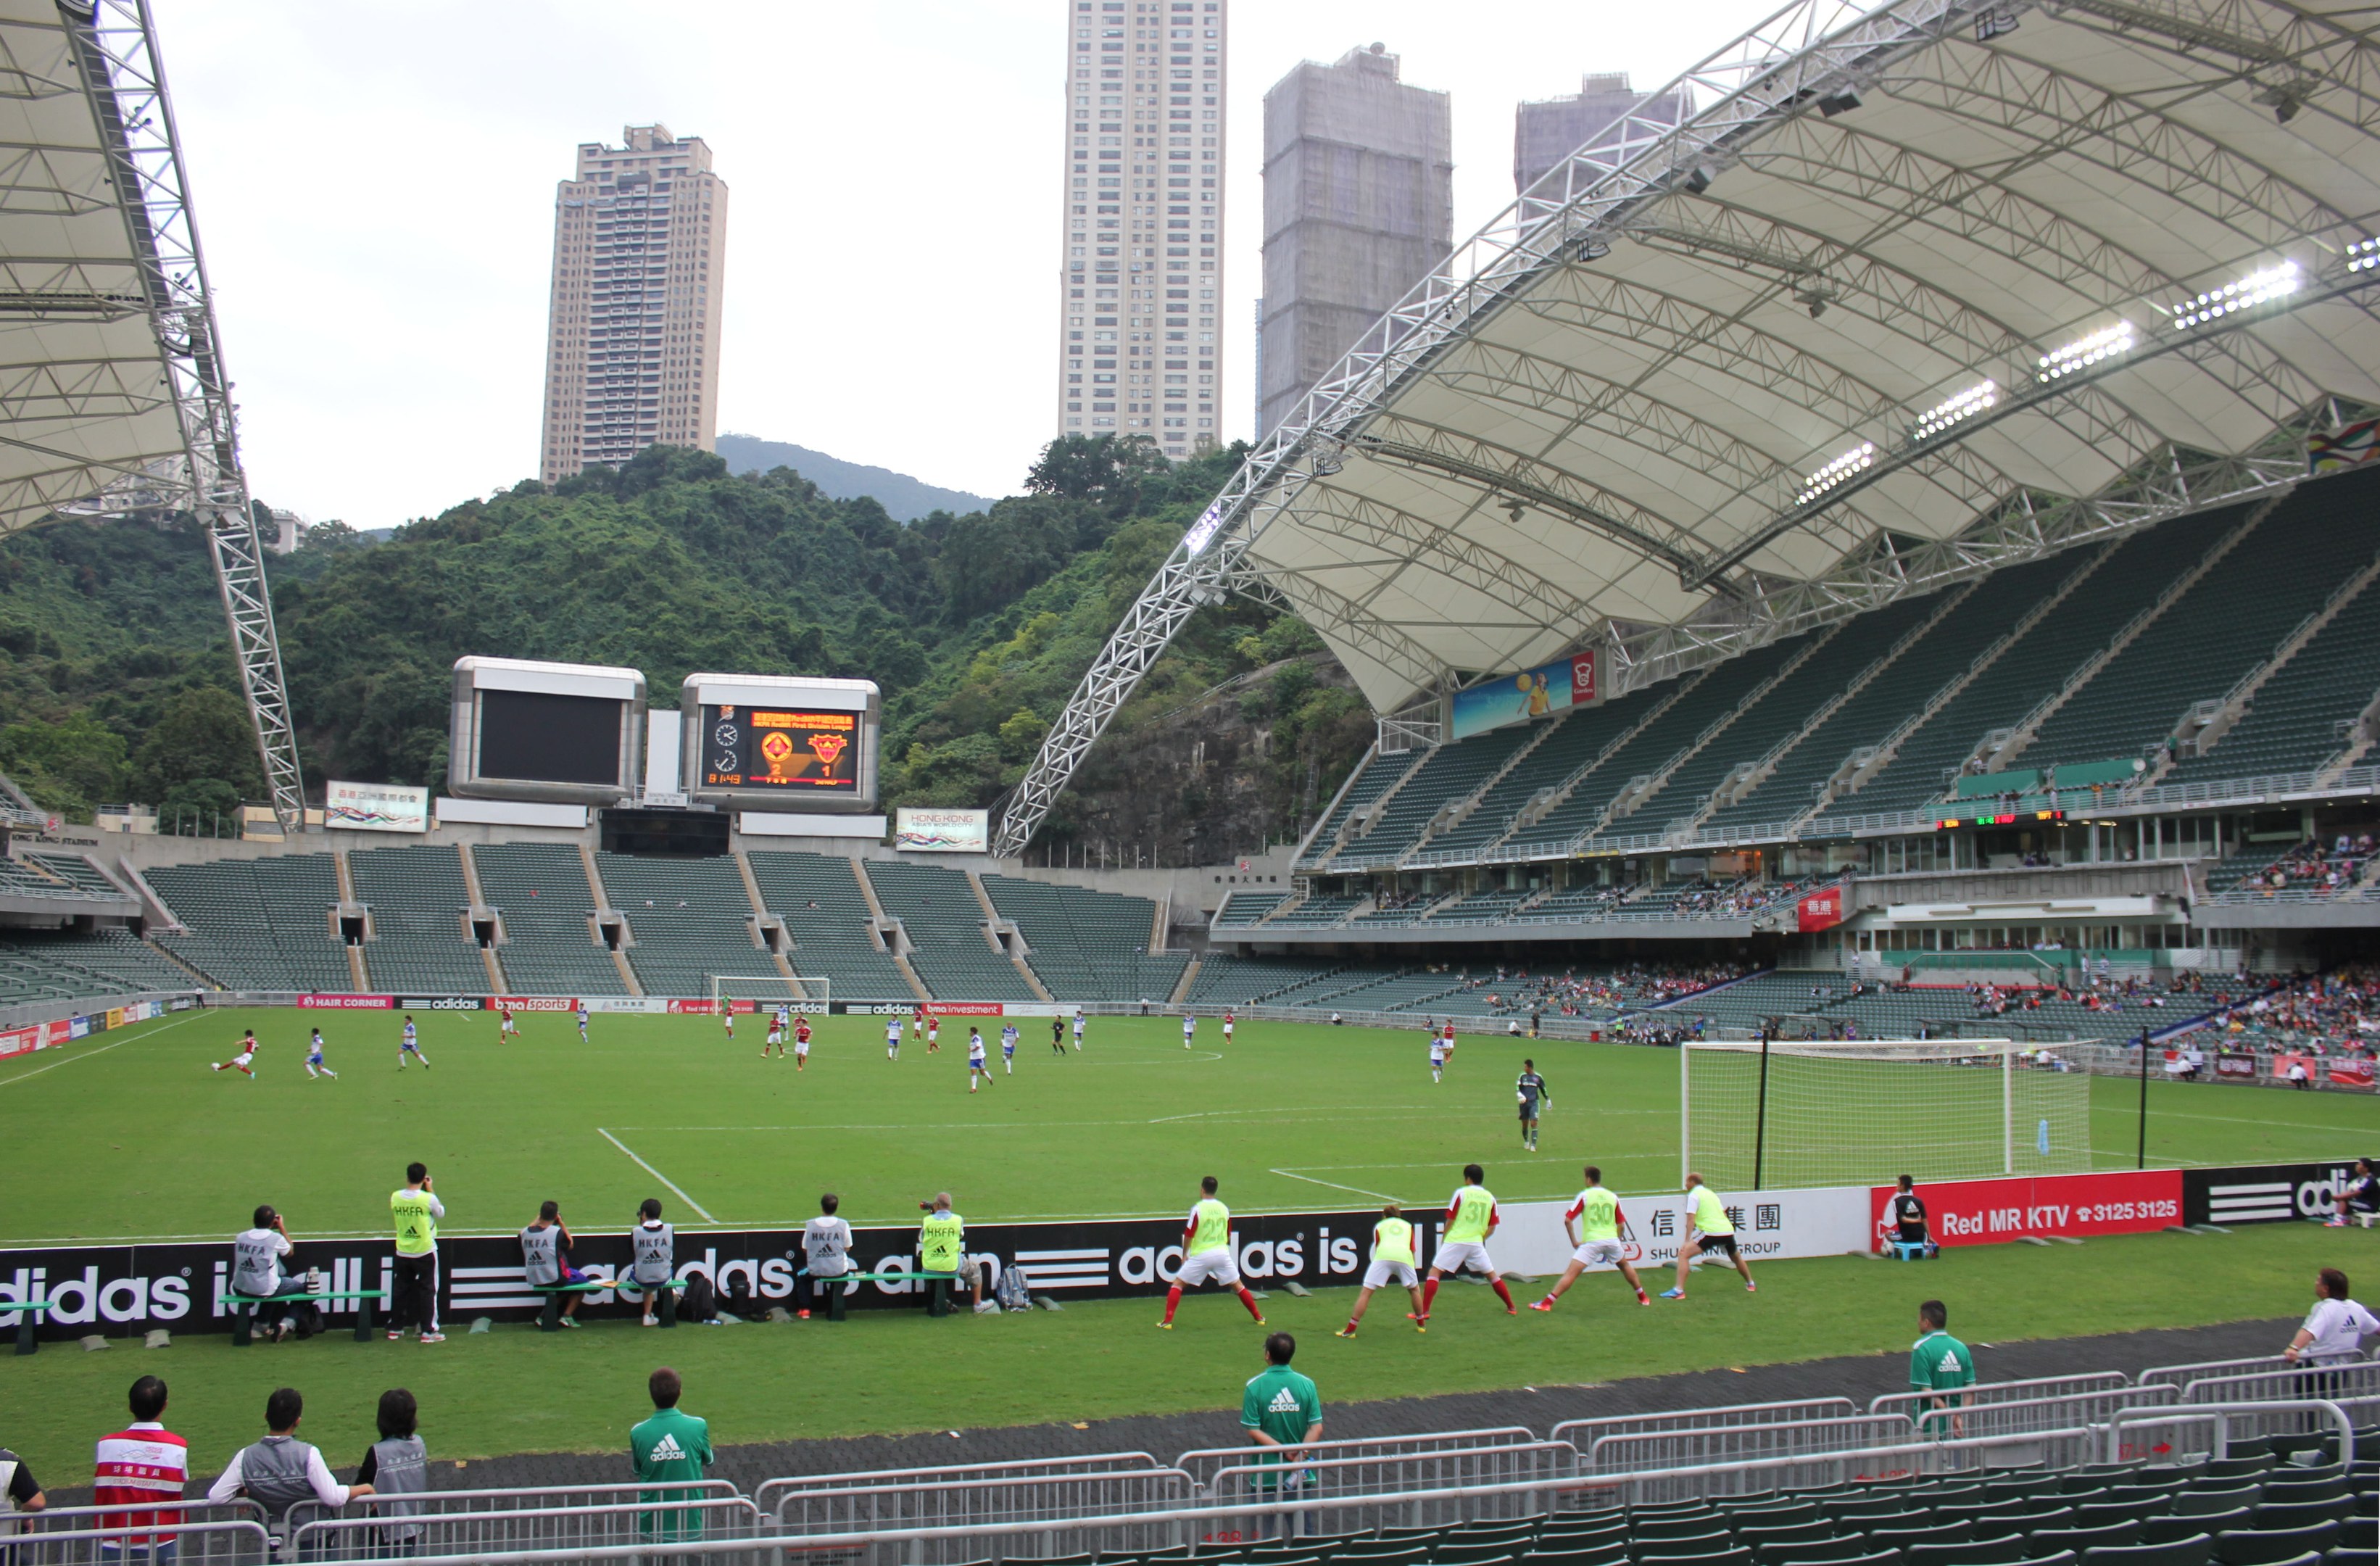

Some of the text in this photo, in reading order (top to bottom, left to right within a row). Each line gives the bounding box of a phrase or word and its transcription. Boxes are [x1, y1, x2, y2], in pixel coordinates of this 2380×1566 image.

[771, 763, 781, 775] 2
[821, 766, 831, 776] 1
[62, 837, 99, 846] STADIUM
[1807, 900, 1832, 912] 香港
[316, 998, 386, 1008] HAIR CORNER
[432, 998, 479, 1010] adidas
[494, 998, 571, 1011] bma sports
[789, 1002, 829, 1014] adidas
[926, 1004, 998, 1014] bma investment
[873, 1004, 915, 1015] adidas
[394, 1206, 423, 1216] HKFA
[1465, 1201, 1488, 1225] 31
[1589, 1202, 1614, 1225] 30
[1651, 1204, 1780, 1237] 信集團
[1943, 1200, 2177, 1235] Red MR KTV 3125 3125
[927, 1227, 955, 1237] HKFA
[1203, 1217, 1226, 1243] 22
[639, 1237, 668, 1247] HKFA
[811, 1232, 839, 1241] HKFA
[238, 1243, 265, 1255] HKFA
[1319, 1227, 1359, 1275] is
[642, 1255, 664, 1264] adidas
[1938, 1364, 1962, 1372] adidas
[1268, 1401, 1300, 1413] adidas
[650, 1450, 686, 1462] adidas
